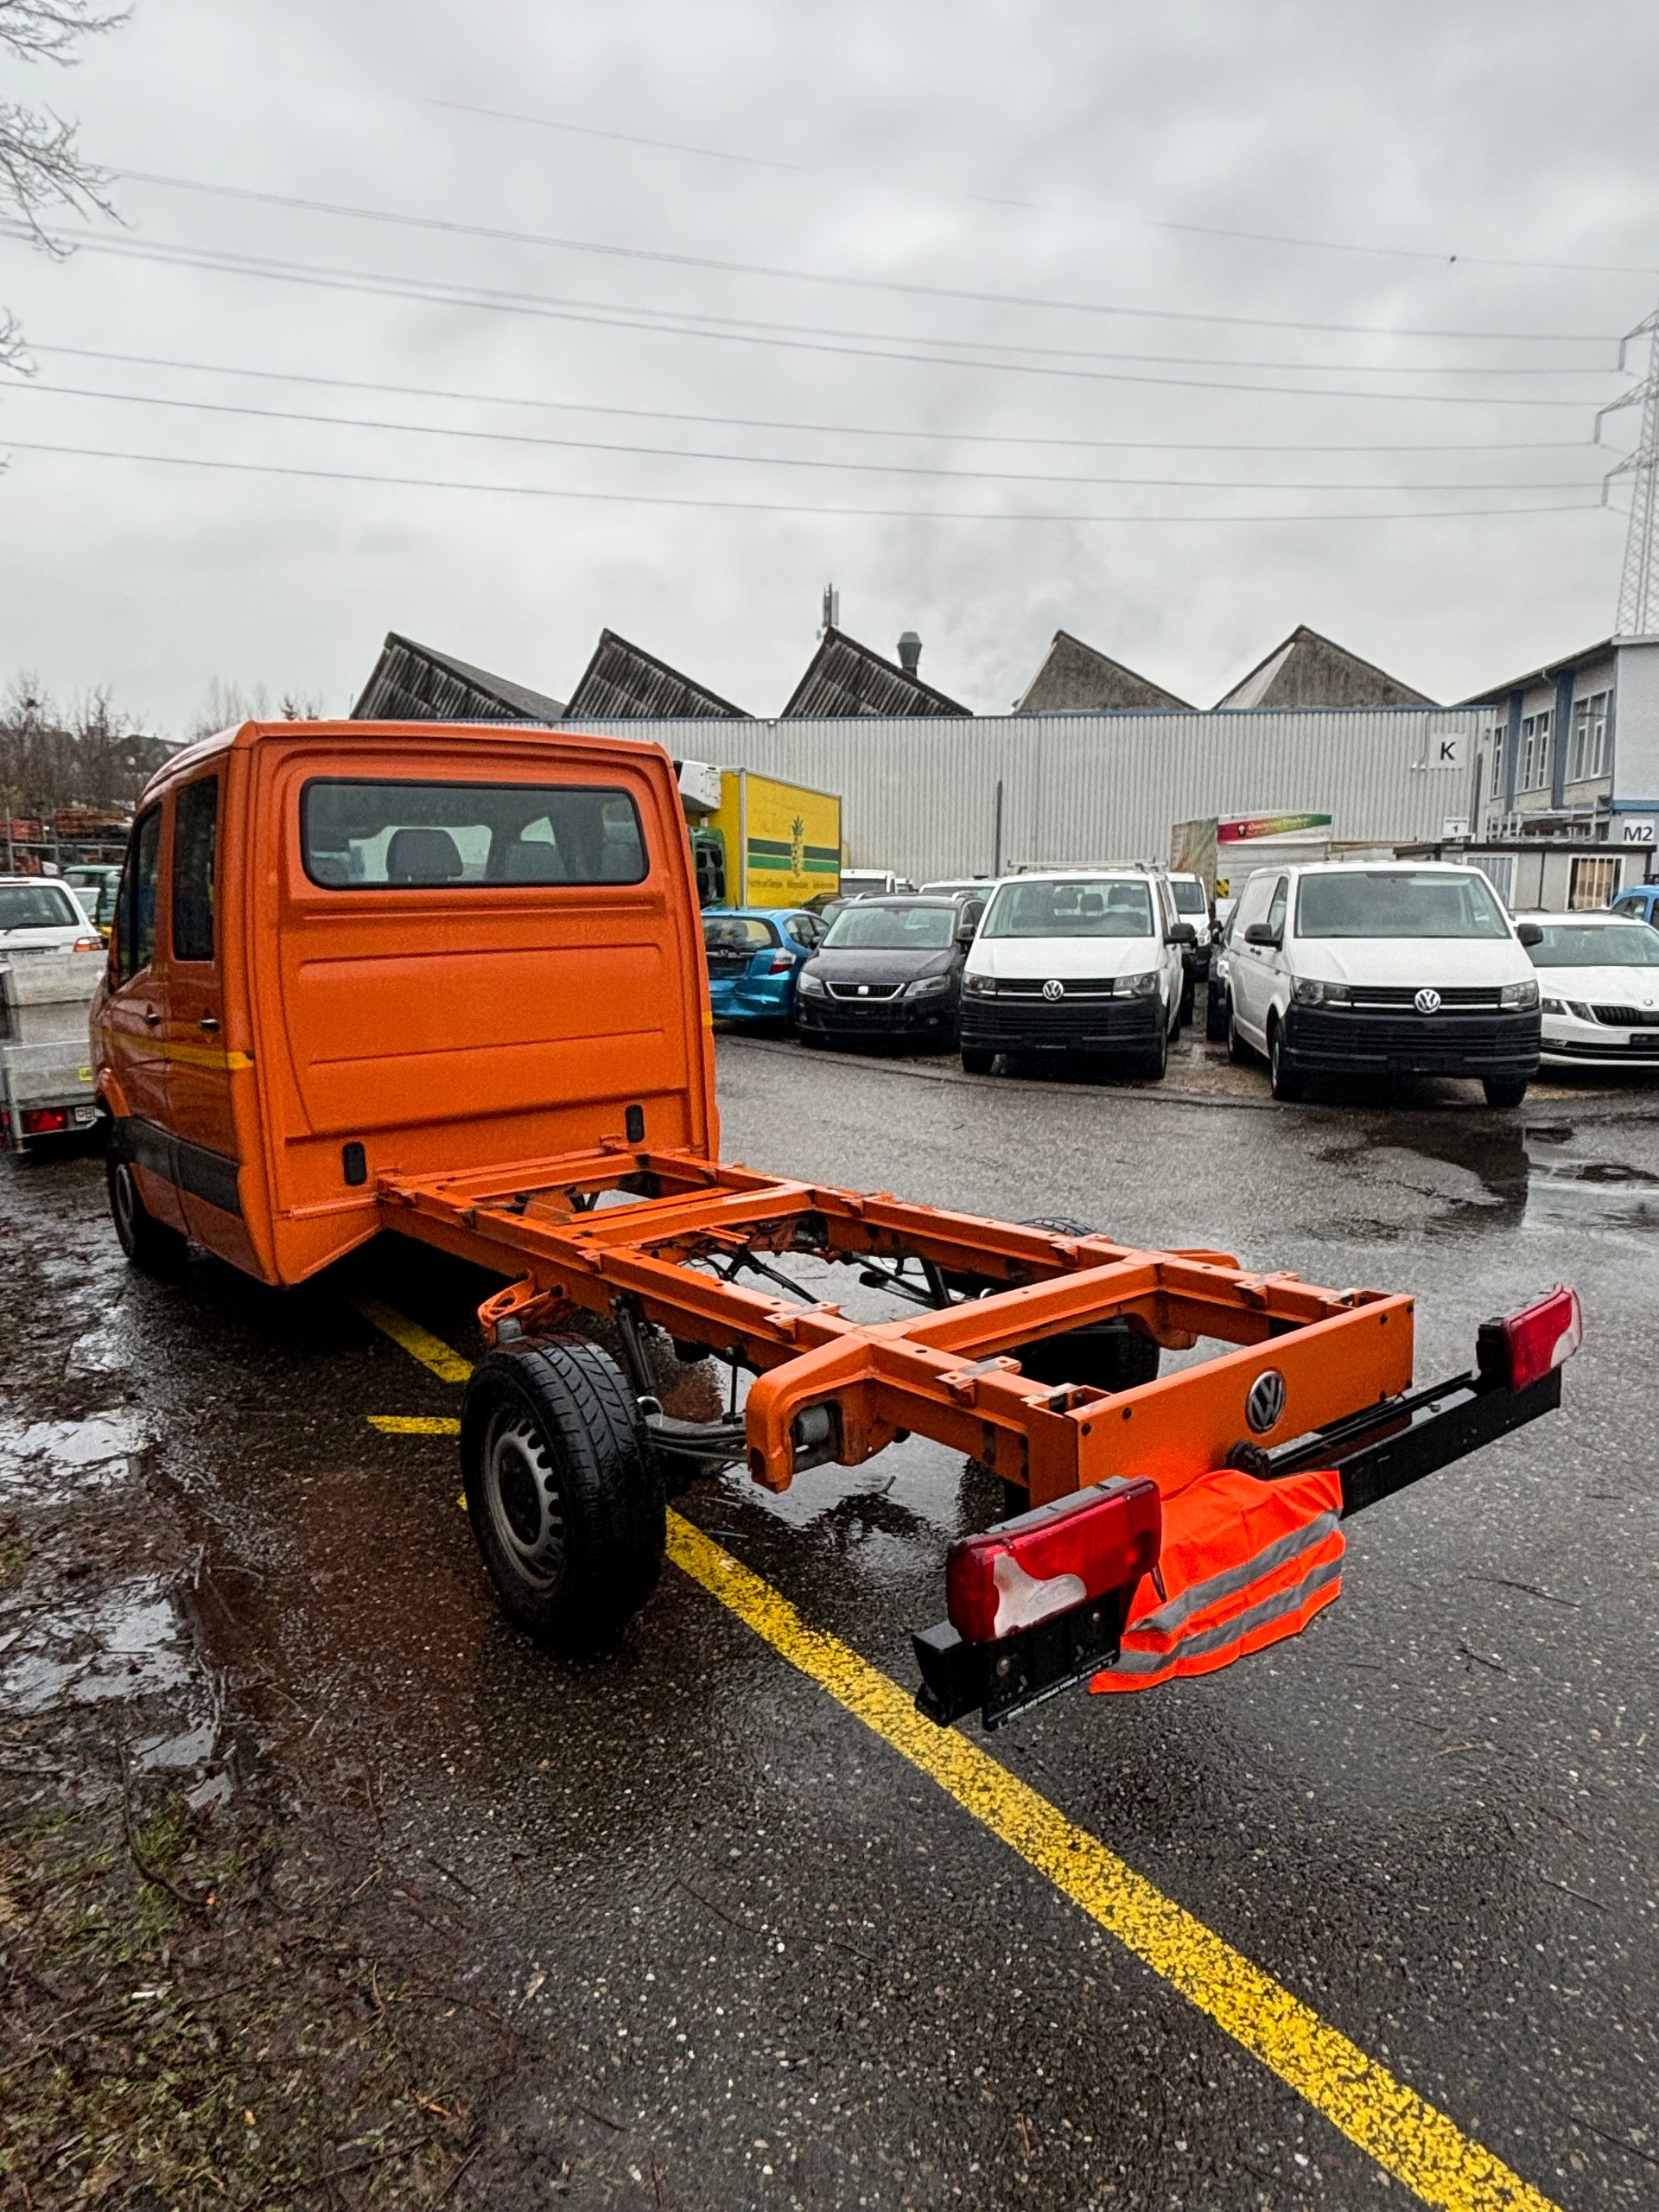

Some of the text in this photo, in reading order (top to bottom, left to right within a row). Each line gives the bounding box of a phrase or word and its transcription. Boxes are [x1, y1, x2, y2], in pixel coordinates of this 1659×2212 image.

[1440, 741, 1456, 761] K
[1452, 824, 1459, 834] 1
[1624, 826, 1653, 842] M2
